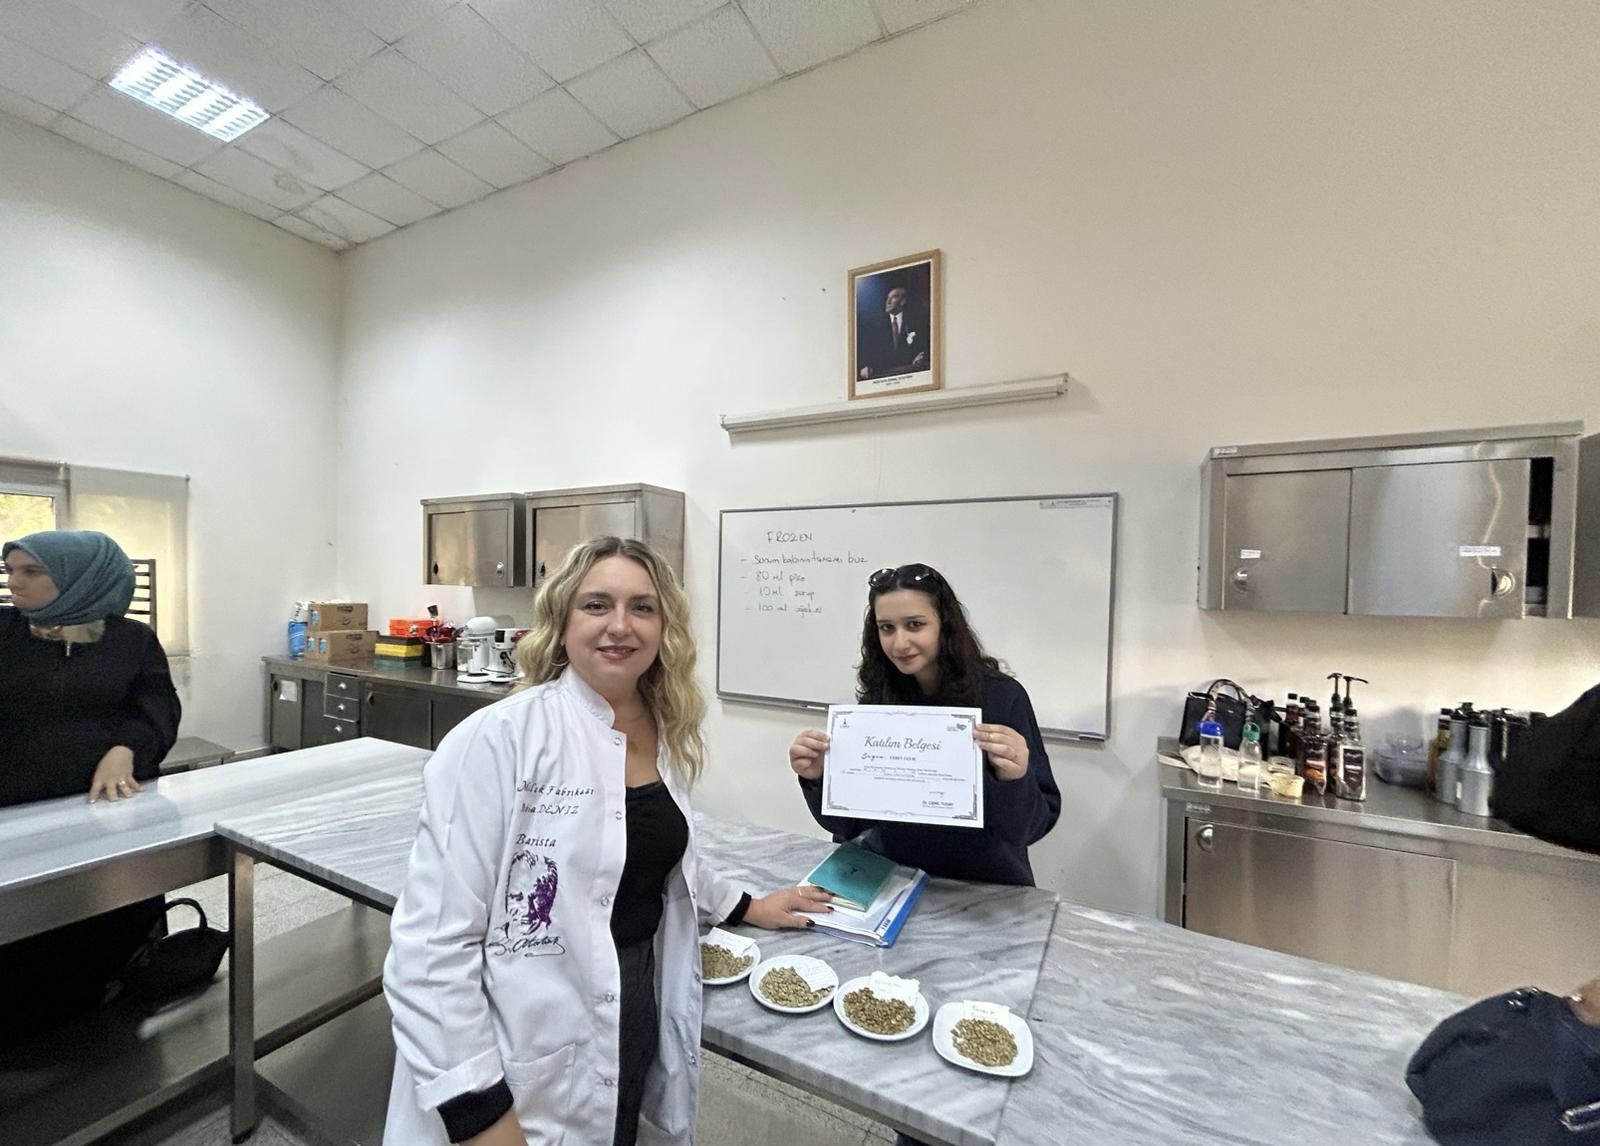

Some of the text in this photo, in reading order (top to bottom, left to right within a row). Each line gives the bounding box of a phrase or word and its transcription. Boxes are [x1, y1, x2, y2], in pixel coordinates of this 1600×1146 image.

[864, 736, 943, 753] Katılım Belgesi
[516, 833, 557, 848] Barista
